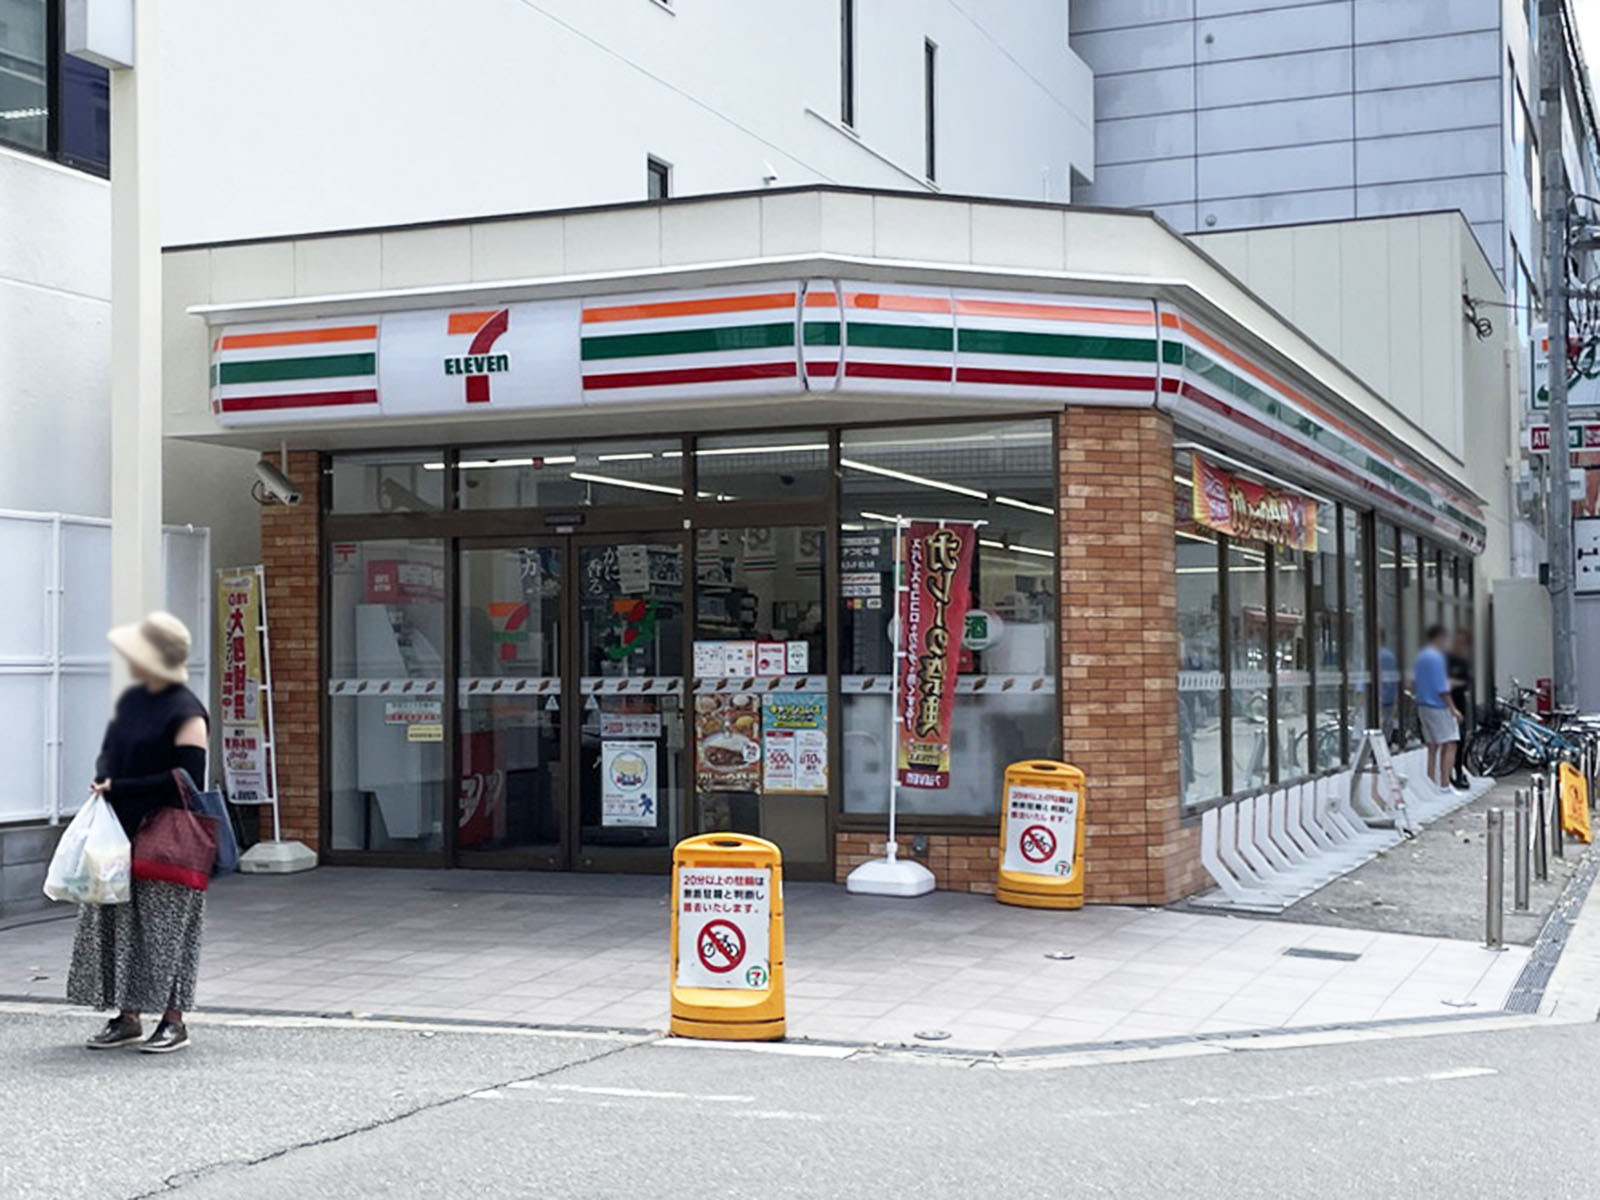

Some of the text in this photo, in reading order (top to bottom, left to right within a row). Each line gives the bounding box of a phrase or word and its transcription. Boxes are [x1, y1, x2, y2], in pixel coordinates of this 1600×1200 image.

[448, 308, 509, 403] 7
[964, 615, 988, 639] 酒
[683, 874, 765, 886] 20分以上の駐輪は
[683, 888, 765, 901] 無断駐輪と判断し
[682, 902, 760, 914] 撤去いたします。
